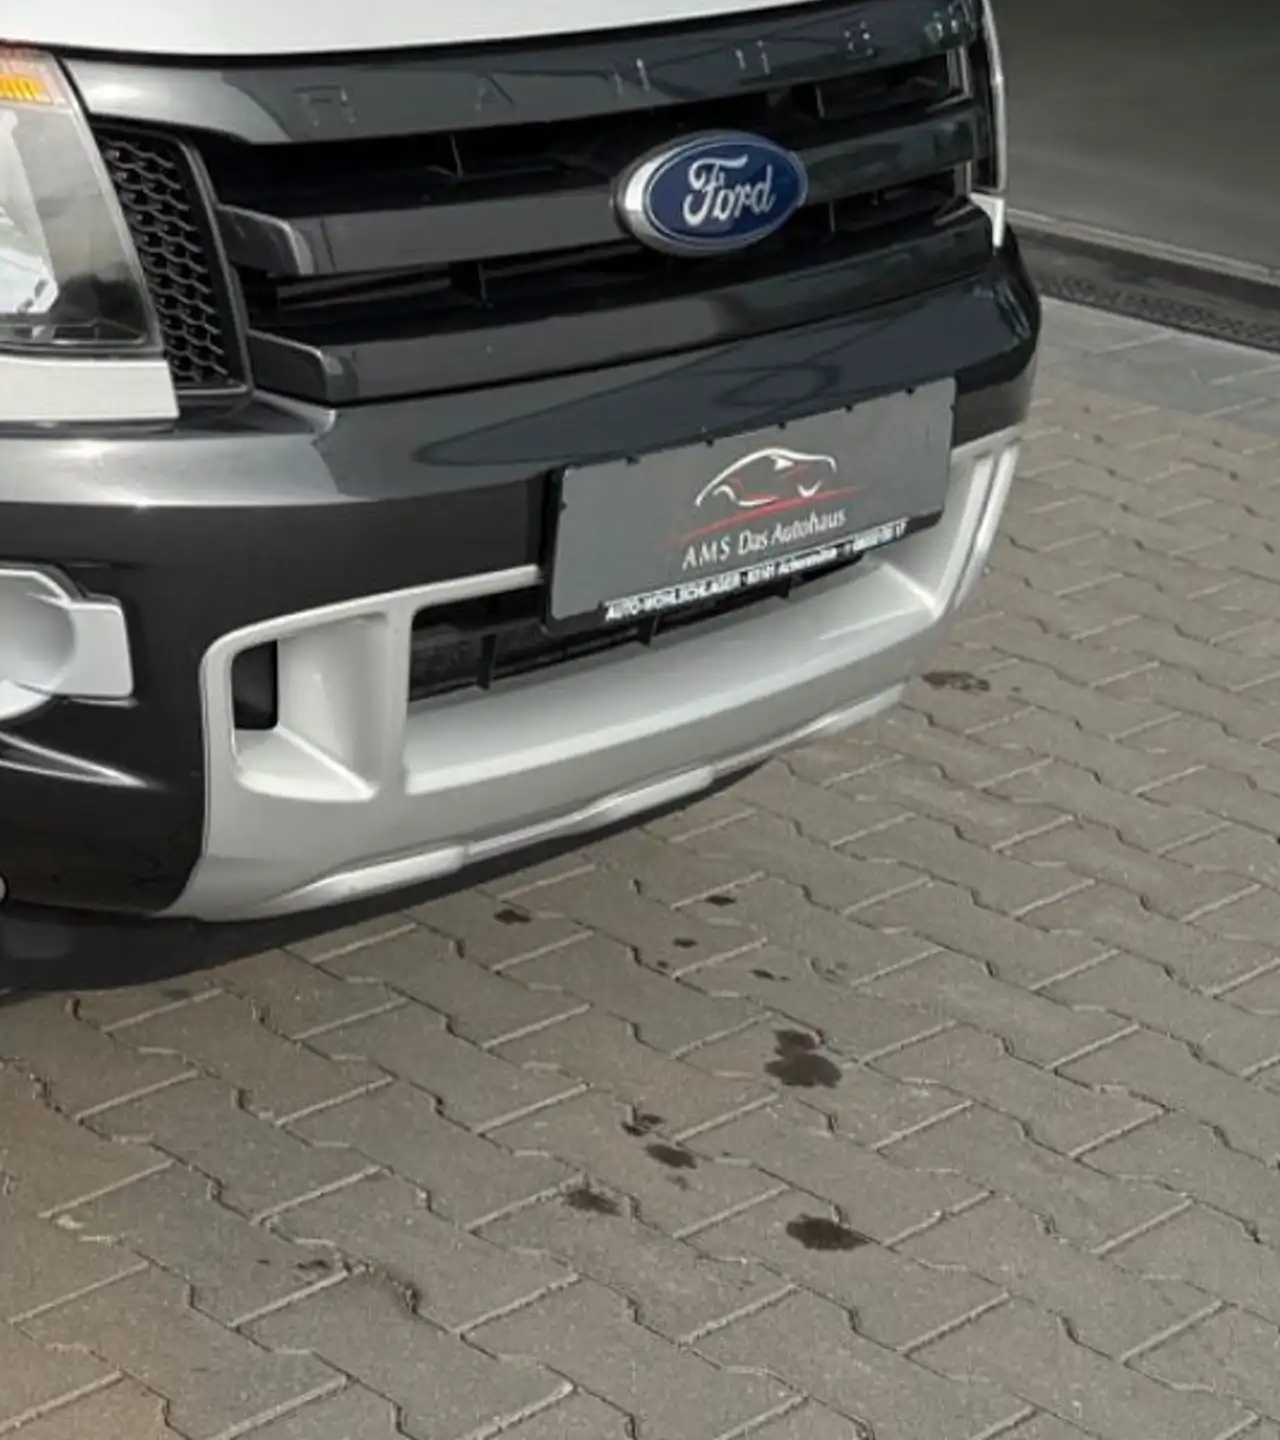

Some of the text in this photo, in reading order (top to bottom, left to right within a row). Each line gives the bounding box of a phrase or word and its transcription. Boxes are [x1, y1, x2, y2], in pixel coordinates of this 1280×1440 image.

[682, 153, 777, 227] Ford
[681, 533, 731, 571] AMS
[737, 528, 768, 555] Das
[770, 508, 847, 545] Autohaus
